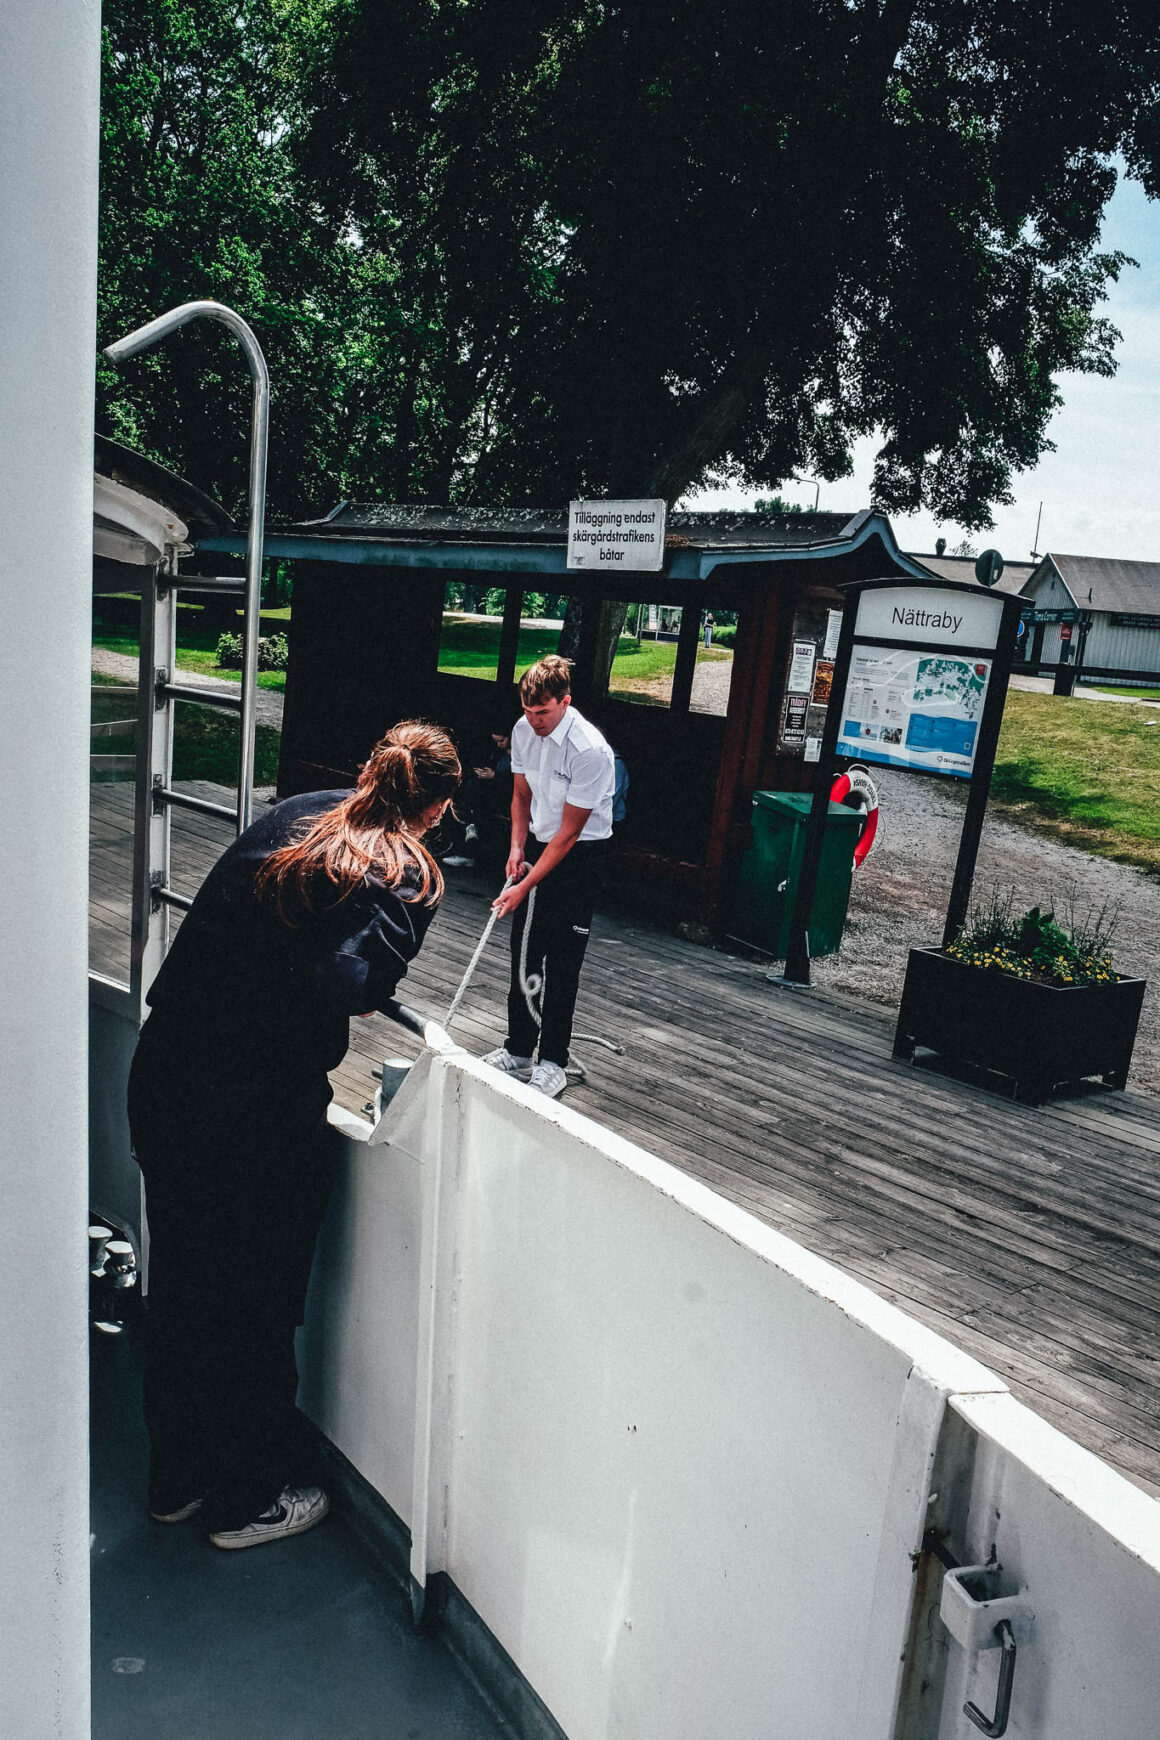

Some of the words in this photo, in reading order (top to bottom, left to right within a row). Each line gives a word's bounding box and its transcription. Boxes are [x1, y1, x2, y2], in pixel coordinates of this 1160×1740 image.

[575, 511, 622, 527] Tilläggning
[624, 511, 655, 523] endast
[573, 529, 655, 545] skärgårdstrafikens
[600, 548, 625, 560] båtar
[892, 607, 963, 633] Nättraby
